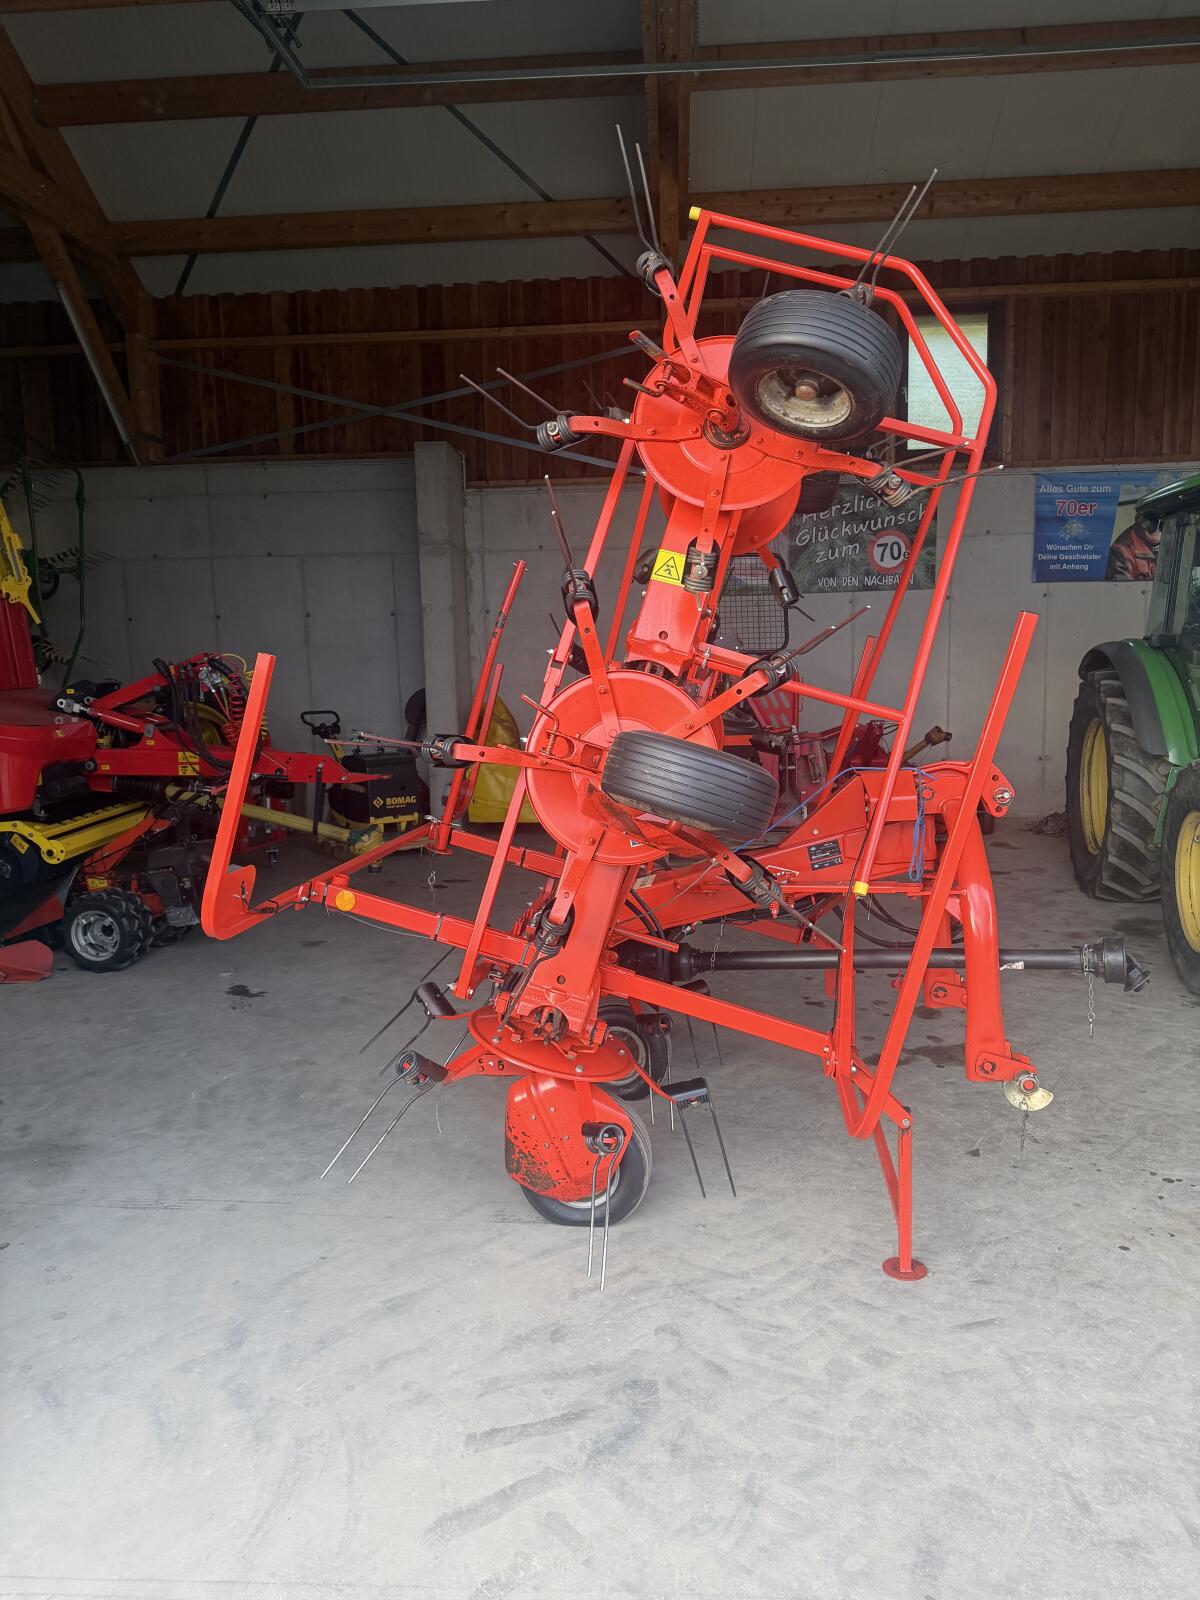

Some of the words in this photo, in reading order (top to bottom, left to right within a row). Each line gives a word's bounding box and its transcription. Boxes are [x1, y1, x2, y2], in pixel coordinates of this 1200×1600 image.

[1039, 484, 1063, 493] Alles
[1066, 484, 1089, 493] Gute
[1091, 485, 1112, 493] zum
[1056, 500, 1097, 516] 70er
[1046, 543, 1082, 551] Wünschen
[1084, 543, 1094, 551] Dir
[816, 543, 860, 563] zum
[1038, 553, 1058, 561] Deine
[1059, 553, 1102, 561] Geschwister
[1062, 563, 1089, 571] Anhang
[818, 577, 837, 587] VON
[842, 575, 859, 586] DEN
[864, 575, 914, 586] NACHBAN
[385, 796, 416, 805] BOMAG
